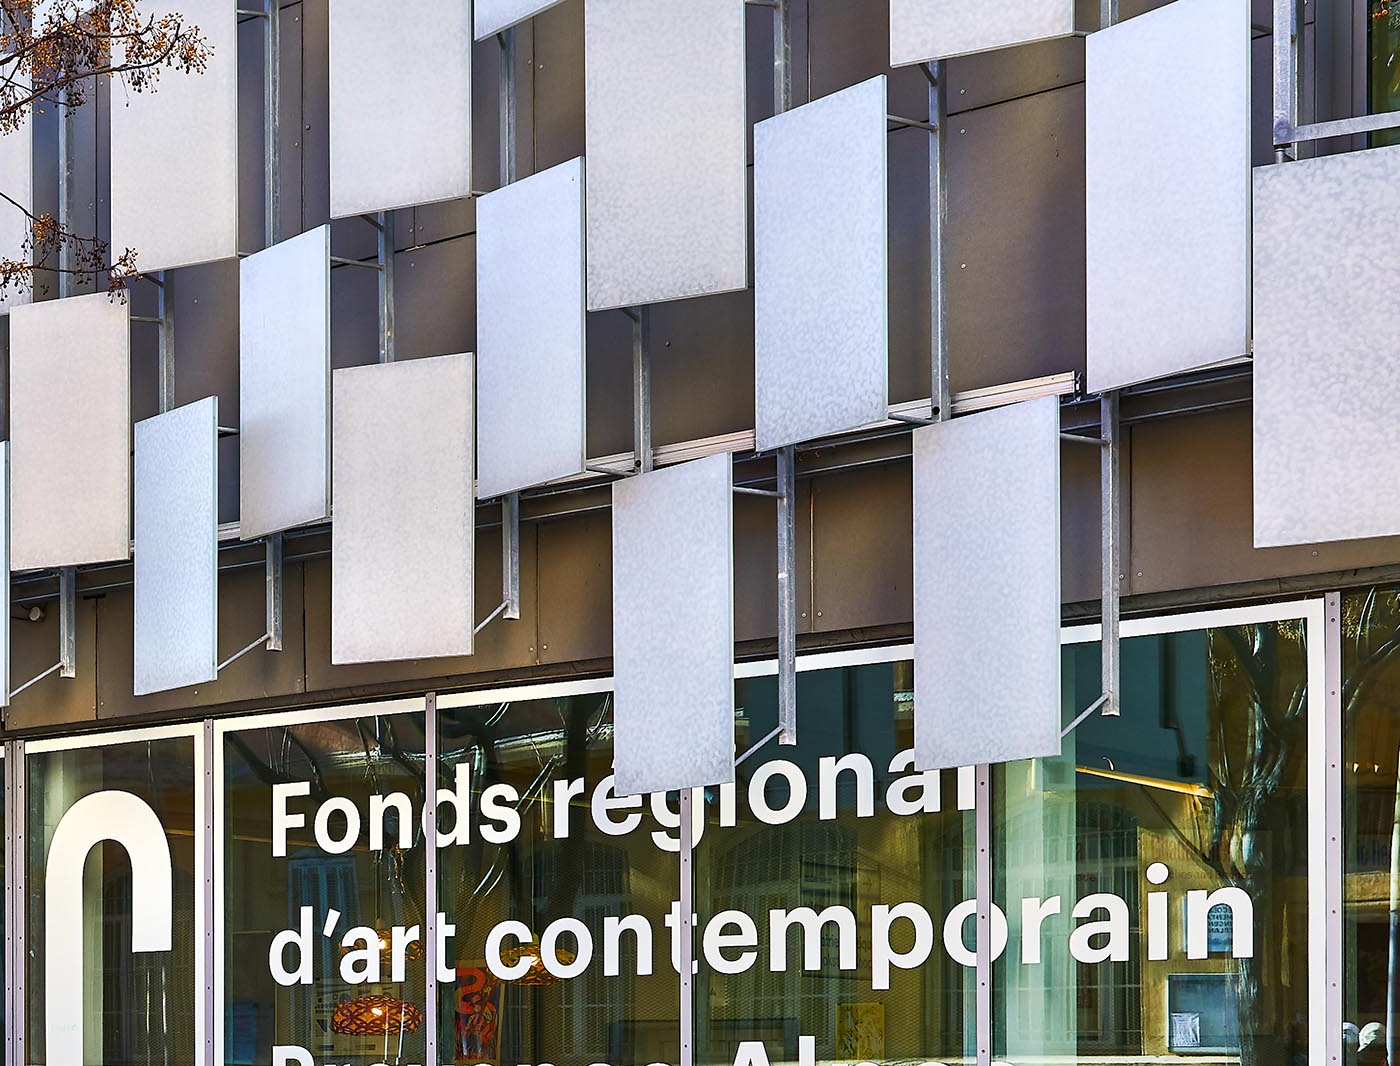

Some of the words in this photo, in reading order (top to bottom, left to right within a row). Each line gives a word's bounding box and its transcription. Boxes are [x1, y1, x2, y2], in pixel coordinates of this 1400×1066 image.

[271, 762, 522, 858] Fonds
[268, 905, 457, 986] d'art
[484, 862, 1255, 991] contemporain
